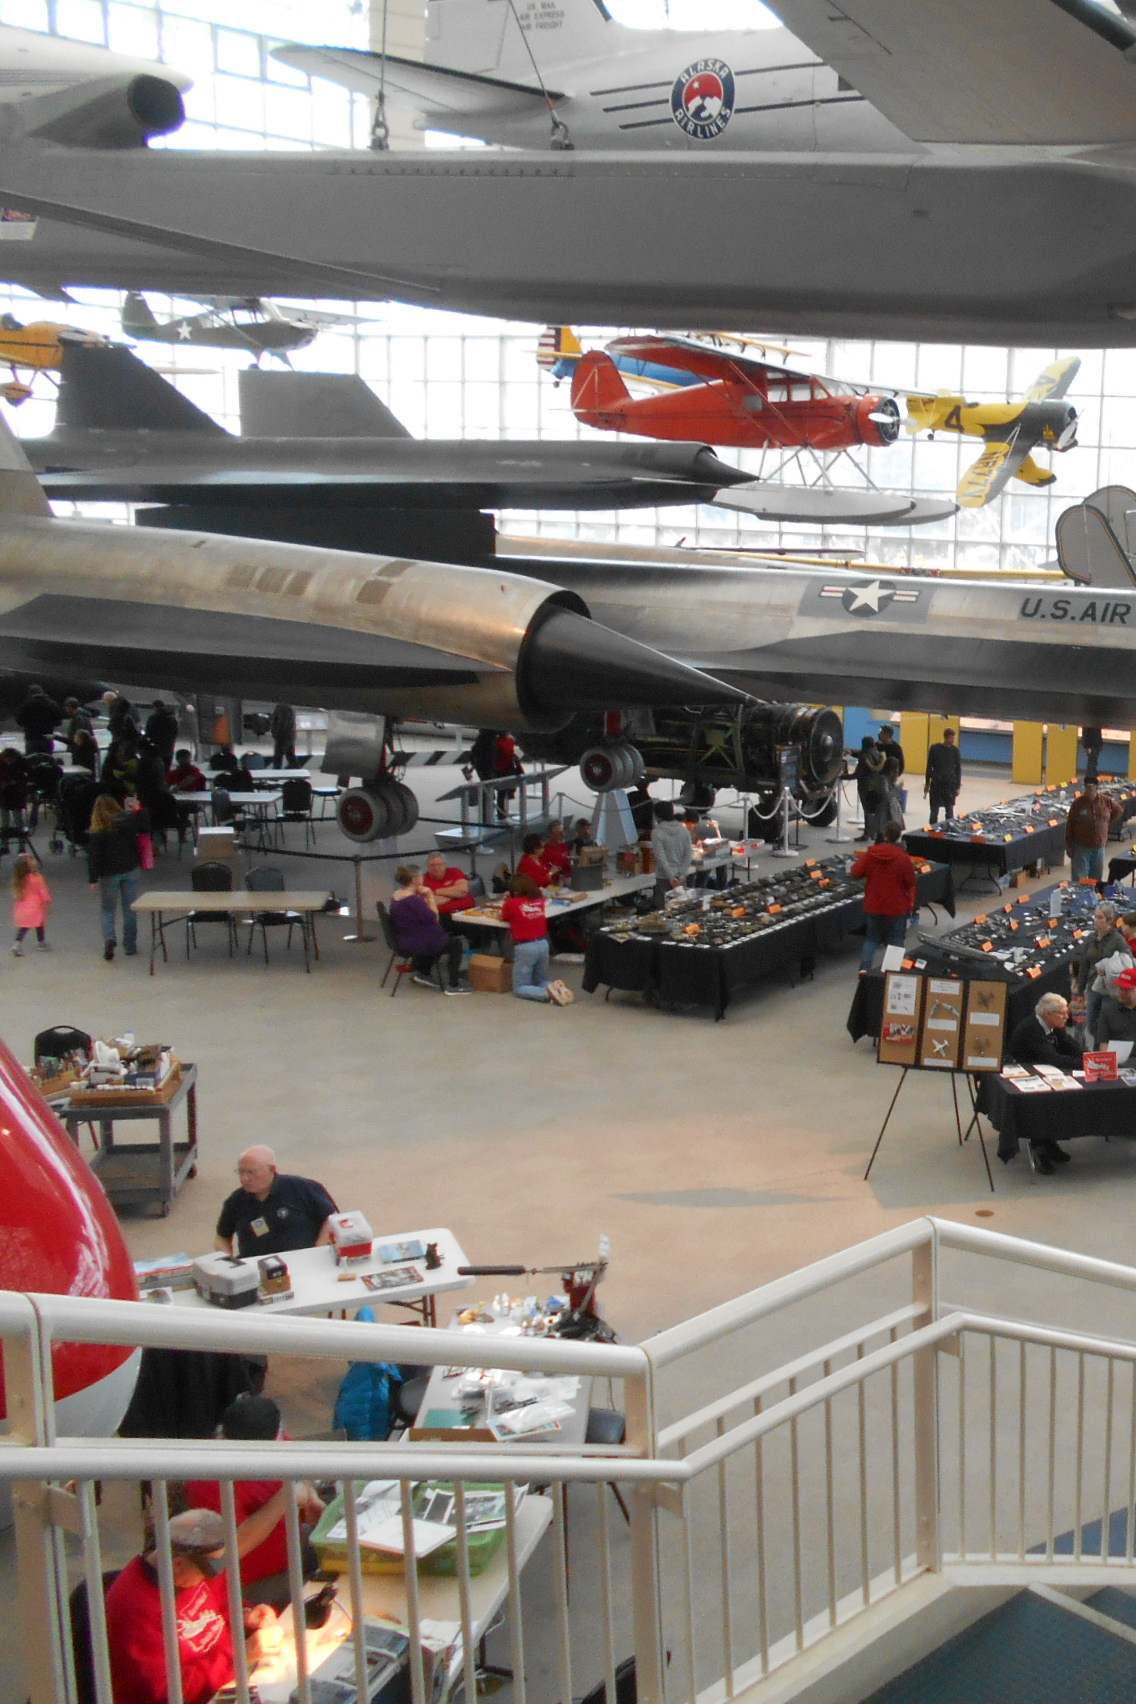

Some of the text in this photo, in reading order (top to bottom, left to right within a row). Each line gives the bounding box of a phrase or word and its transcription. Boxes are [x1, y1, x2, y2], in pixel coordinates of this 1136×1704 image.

[534, 10, 564, 20] EXPRESS
[535, 20, 562, 30] FREIGHT
[680, 59, 730, 84] ALASKA
[674, 106, 731, 139] AIRLINES
[945, 404, 965, 434] 4
